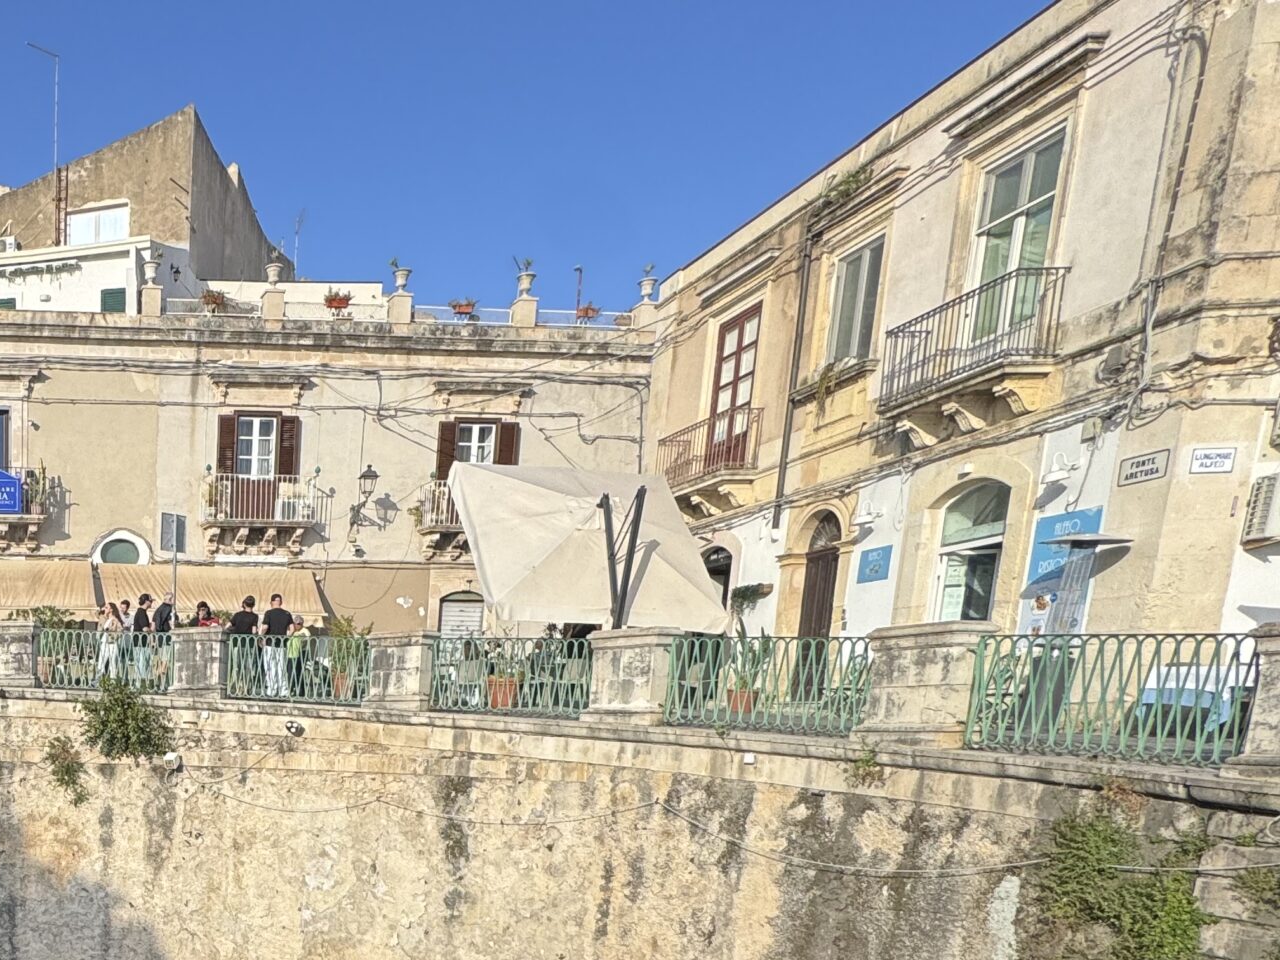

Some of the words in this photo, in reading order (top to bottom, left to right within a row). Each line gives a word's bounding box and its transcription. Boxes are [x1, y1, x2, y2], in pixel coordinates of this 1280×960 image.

[1130, 456, 1157, 470] FONTE
[1199, 460, 1225, 469] ALFEO
[1124, 467, 1160, 481] ARETUSA
